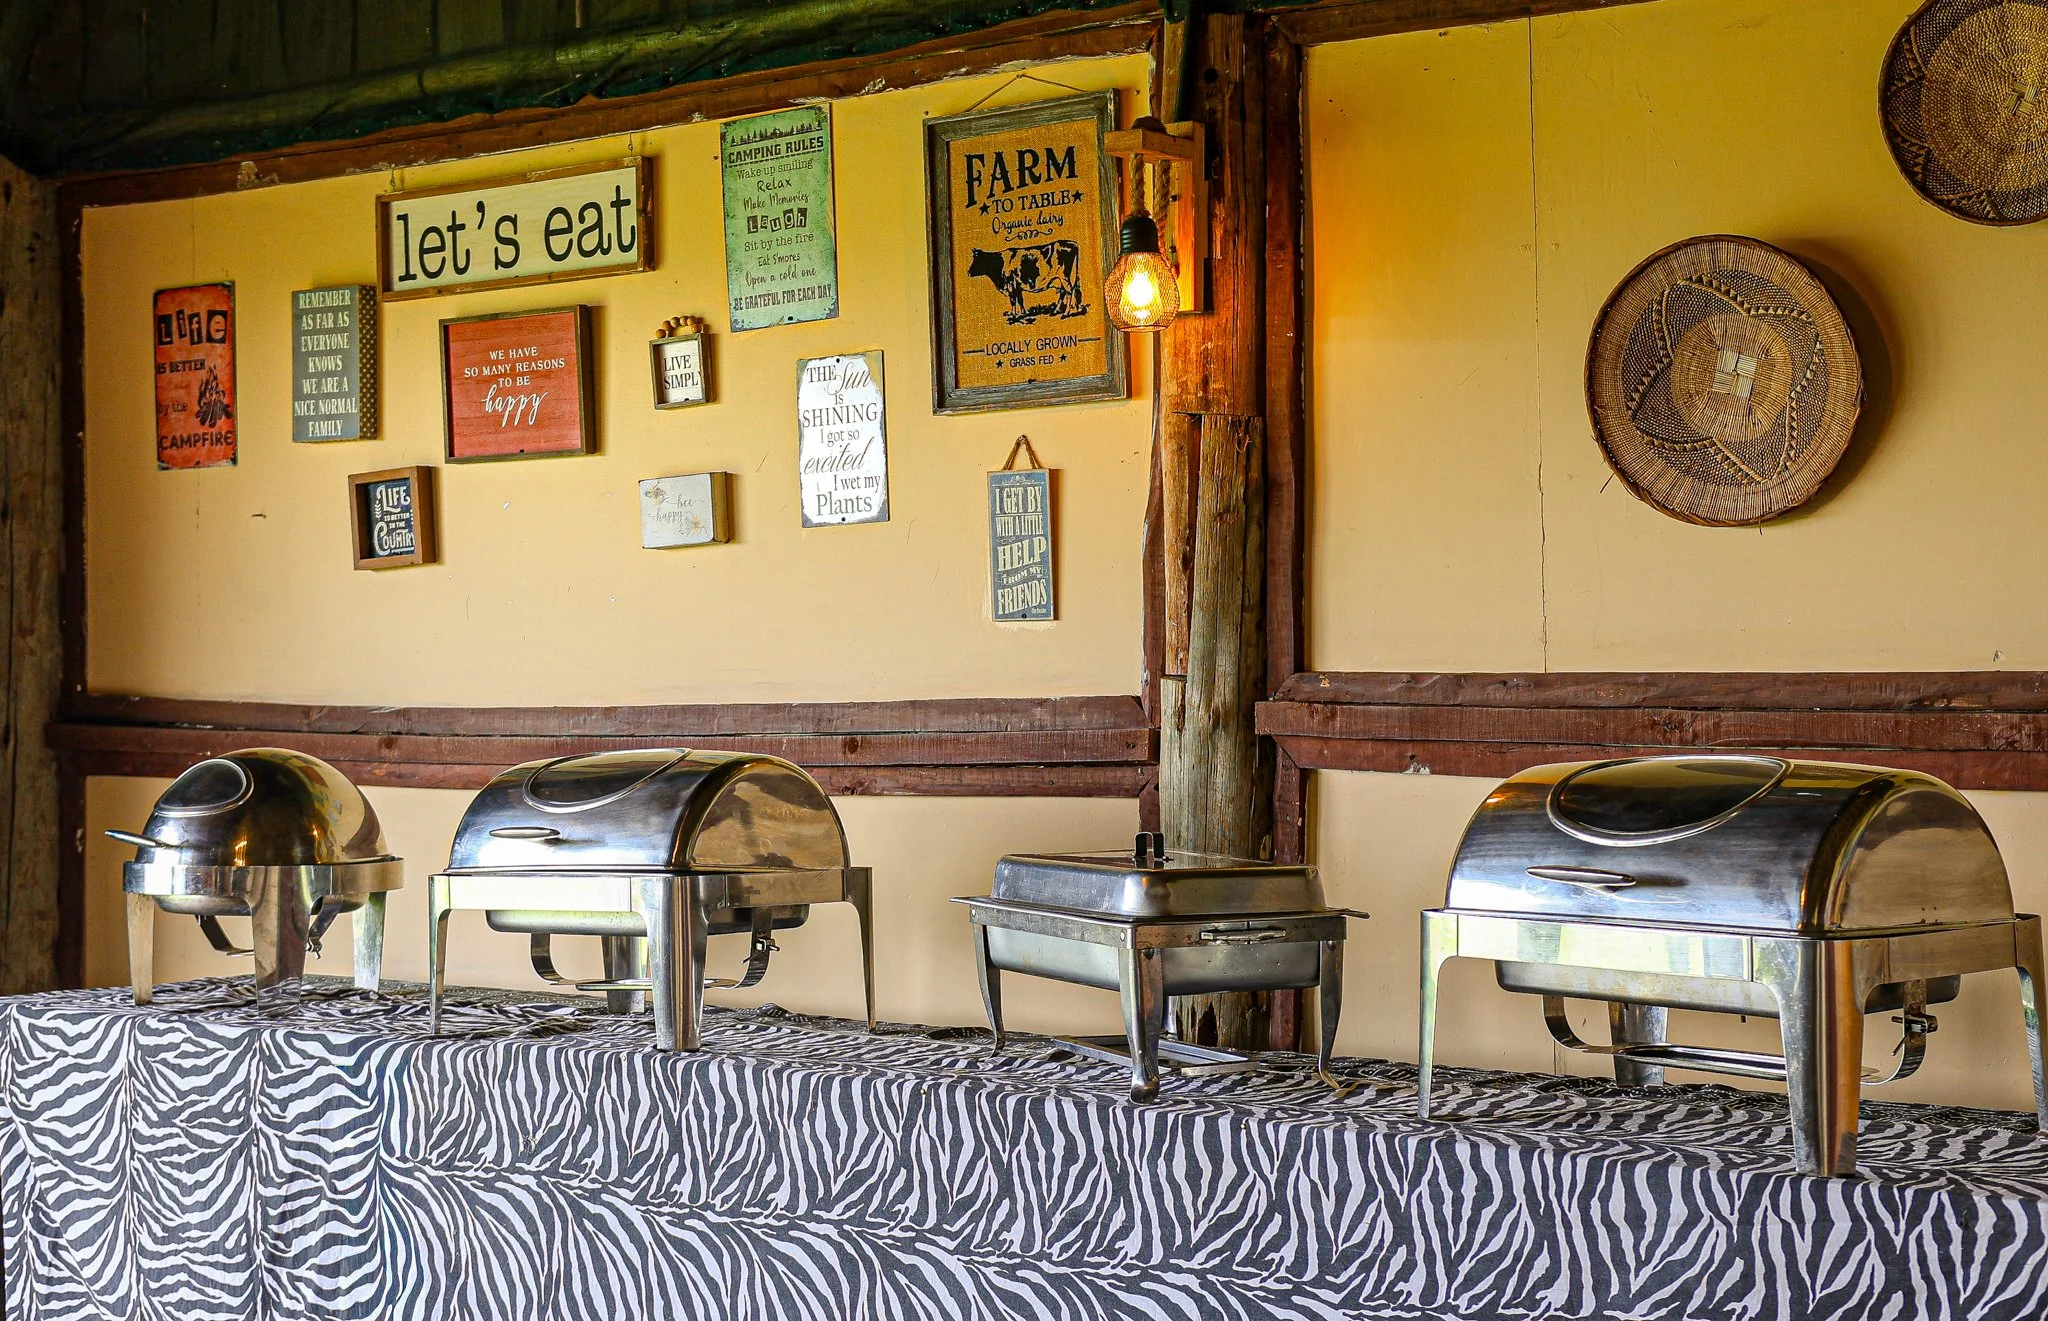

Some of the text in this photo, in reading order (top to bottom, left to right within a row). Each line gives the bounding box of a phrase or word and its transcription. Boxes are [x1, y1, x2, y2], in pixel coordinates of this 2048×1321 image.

[728, 136, 824, 164] CAMPING RULES
[737, 157, 814, 180] Wake up smiling
[965, 145, 1079, 209] FARM
[757, 177, 793, 193] Relax
[743, 189, 810, 211] Make Memories
[992, 189, 1071, 214] TO TABLE
[747, 207, 808, 234] Laugh
[992, 210, 1064, 235] Organic dairy
[396, 184, 637, 283] let's eat
[744, 232, 815, 252] Sit by the fire
[757, 251, 801, 267] Eat S'mores
[745, 270, 767, 289] Open
[779, 264, 798, 281] cold
[801, 267, 817, 277] one
[299, 289, 351, 309] REMEMBER
[733, 283, 832, 312] BE GRATEFUL FOR EACH DAY
[301, 311, 350, 331] AS FAR AS
[301, 333, 350, 352] EVERYONE
[985, 334, 1077, 356] LOCALLY GROWN
[308, 355, 343, 373] KNOWS
[489, 346, 538, 361] WE HAVE
[663, 354, 692, 372] LIVE
[1009, 354, 1054, 368] GRASS FED
[169, 358, 206, 374] BETTER
[464, 357, 566, 378] SO MANY REASONS
[302, 376, 349, 395] WE ARE A
[498, 376, 531, 387] TO BE
[806, 361, 872, 396] THE Sun
[294, 397, 358, 417] NICE NORMAL
[481, 384, 549, 428] happy
[834, 390, 844, 405] is
[802, 402, 878, 429] SHINING
[308, 419, 344, 438] FAMILY
[820, 428, 860, 448] I got so
[159, 430, 234, 451] CAMPFIRE
[803, 436, 876, 475] excited
[833, 474, 881, 494] I wet my
[376, 484, 411, 513] LIFE
[815, 490, 873, 517] Plants
[995, 486, 1043, 514] I GET BY
[655, 506, 684, 527] happy
[996, 515, 1043, 538] WITH A LITTLE
[997, 536, 1047, 572] HELP
[1003, 566, 1042, 585] FROM MY
[997, 578, 1047, 615] FRIENDS
